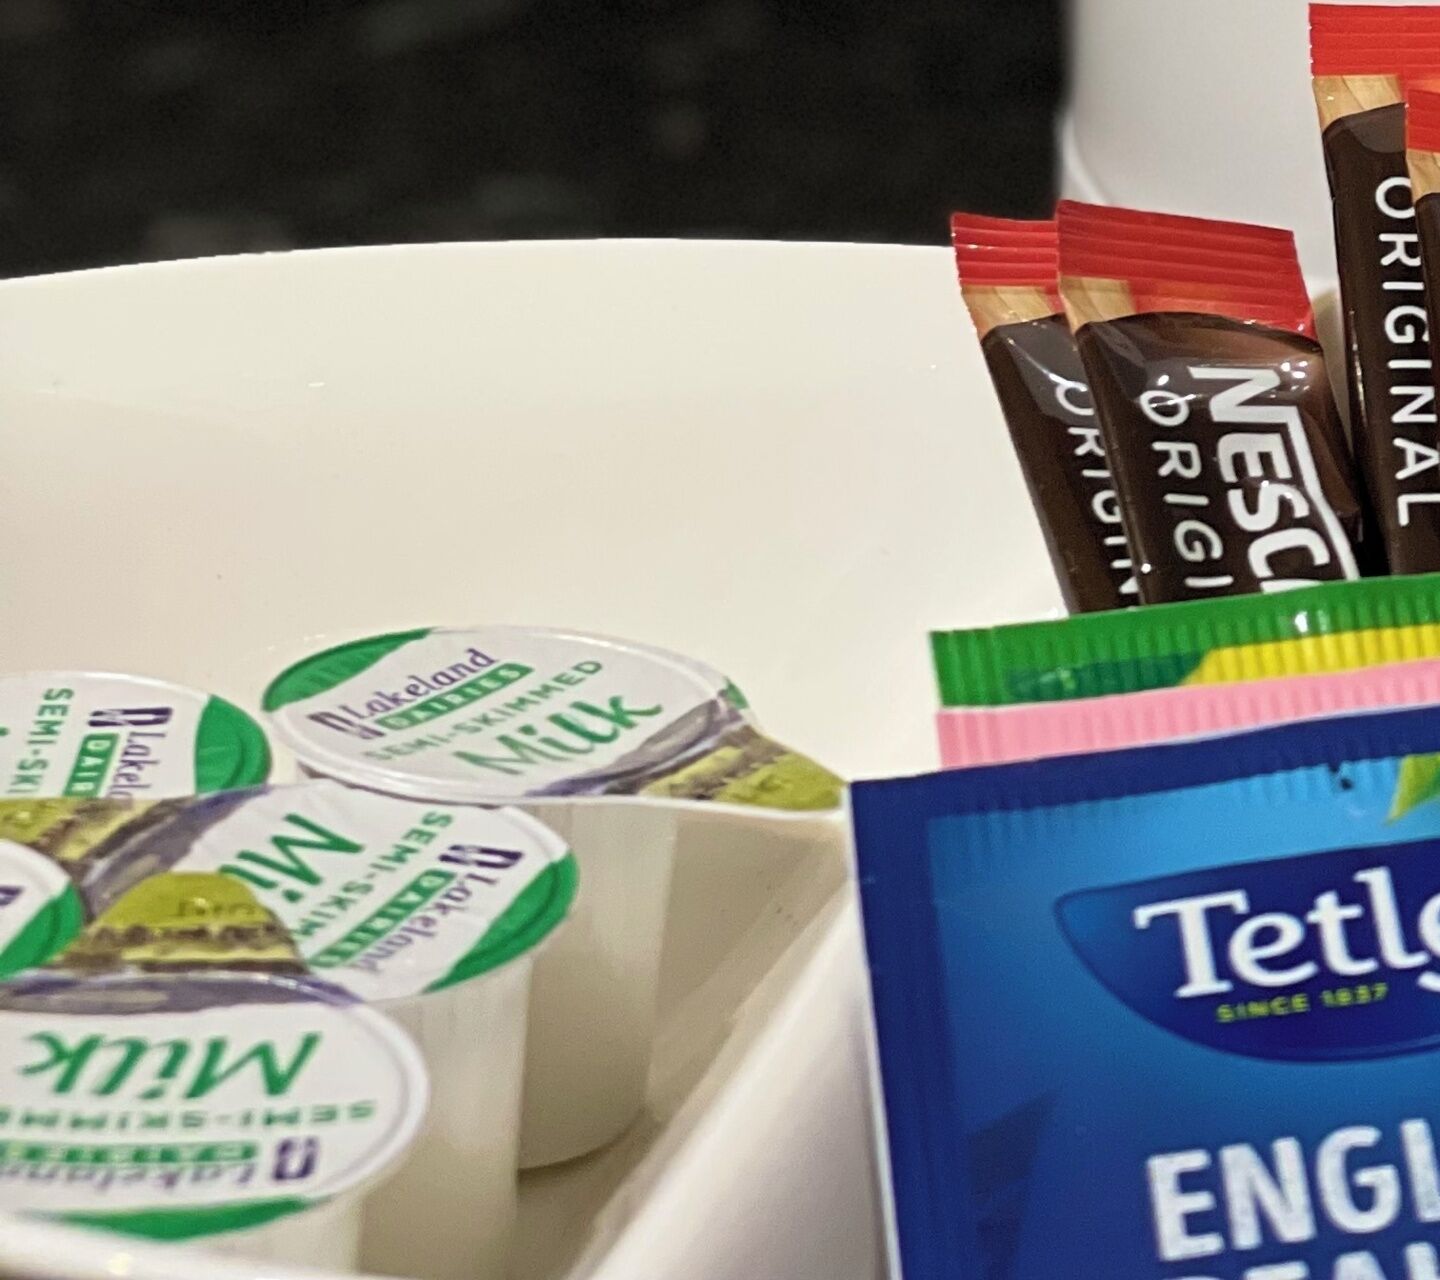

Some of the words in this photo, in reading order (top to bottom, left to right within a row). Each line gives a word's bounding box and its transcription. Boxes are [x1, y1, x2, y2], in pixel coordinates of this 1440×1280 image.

[1138, 388, 1235, 589] ORIGI
[1187, 365, 1359, 593] NESC
[337, 647, 498, 721] Lakeland
[363, 660, 604, 761] SEMI-SKIMMED
[7, 687, 75, 794] SEMI-SKI
[70, 738, 112, 793] DAIR
[451, 695, 664, 776] Milk
[290, 811, 453, 937] SEMI-SKIM
[1214, 993, 1311, 1024] SINCE
[1320, 981, 1388, 1009] 1837
[18, 1030, 324, 1101] Milk
[0, 1101, 375, 1131] SEMI-SKIMM
